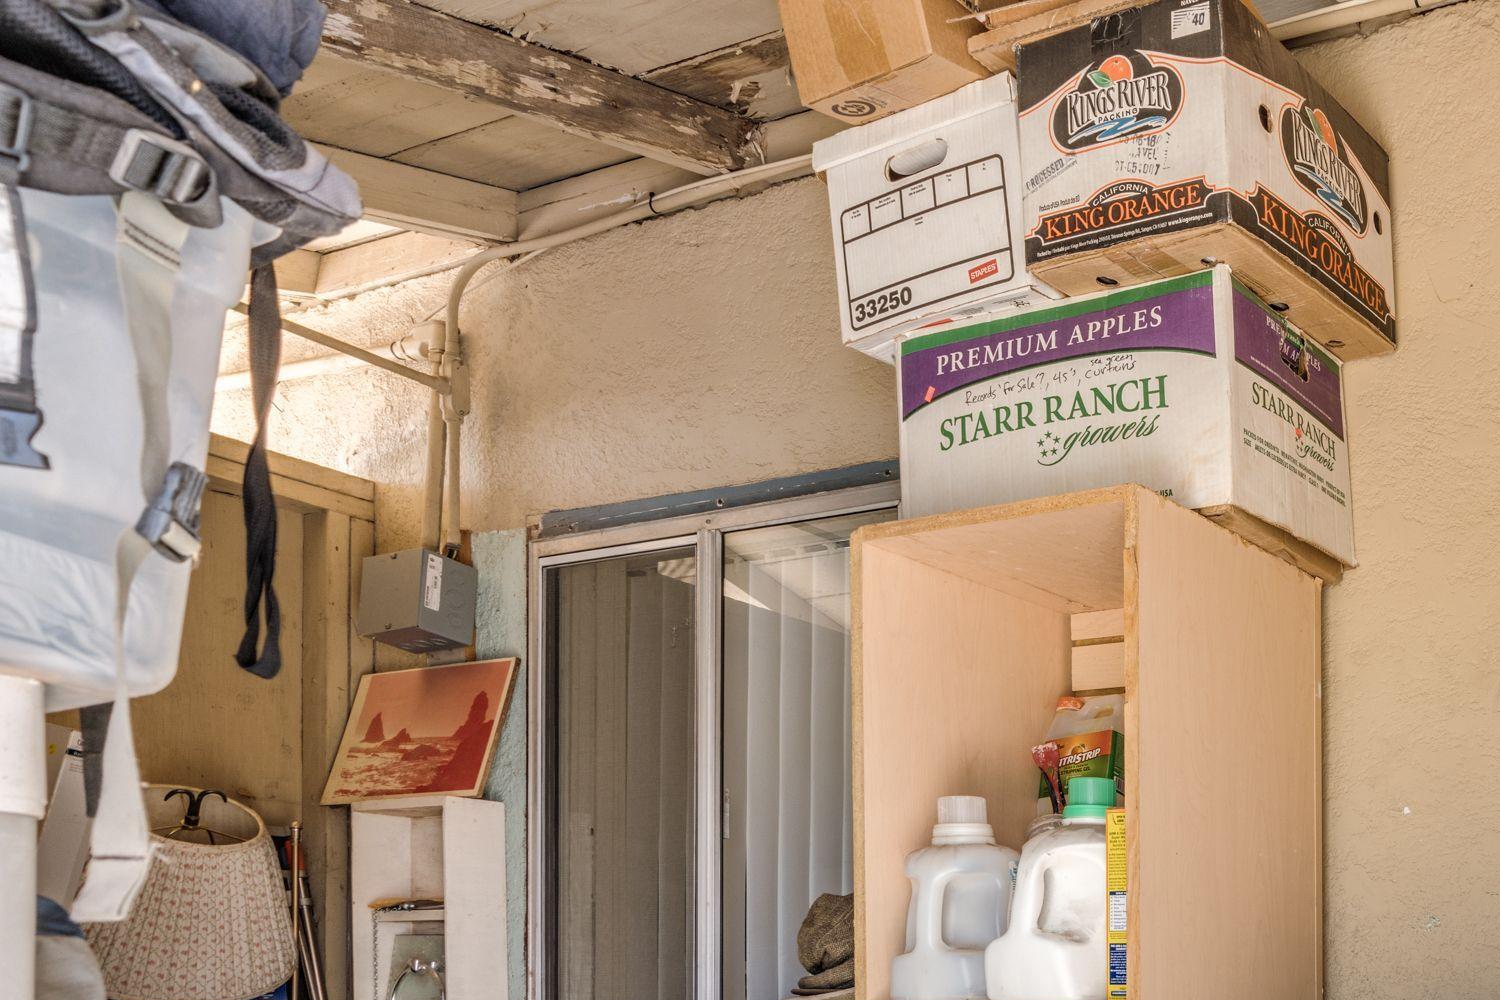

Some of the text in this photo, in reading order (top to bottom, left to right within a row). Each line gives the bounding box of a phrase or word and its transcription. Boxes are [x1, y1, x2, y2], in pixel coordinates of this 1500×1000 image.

[1192, 12, 1205, 26] 40
[1068, 73, 1171, 128] KINGS RIVER
[1098, 107, 1138, 124] PACKING
[1025, 158, 1066, 192] PROCESSED
[1291, 108, 1363, 223] KINGS RIVER
[1316, 168, 1344, 199] PACKING
[1044, 206, 1105, 240] KING
[1108, 184, 1202, 225] ORANGE
[1092, 182, 1149, 207] CALIFORNIA
[1261, 192, 1384, 316] KING ORANGE
[1308, 216, 1353, 262] CALIFORNIA
[970, 261, 997, 281] STAPLES
[854, 286, 913, 323] 33250
[936, 305, 1163, 376] PREMIUM APPLES
[939, 374, 1170, 452] STARR RANCH
[1251, 381, 1296, 428] STARR
[1296, 411, 1337, 462] RANCH
[1046, 415, 1161, 464] growers
[1299, 444, 1335, 473] growers
[1058, 747, 1101, 767] ITRISTRIP
